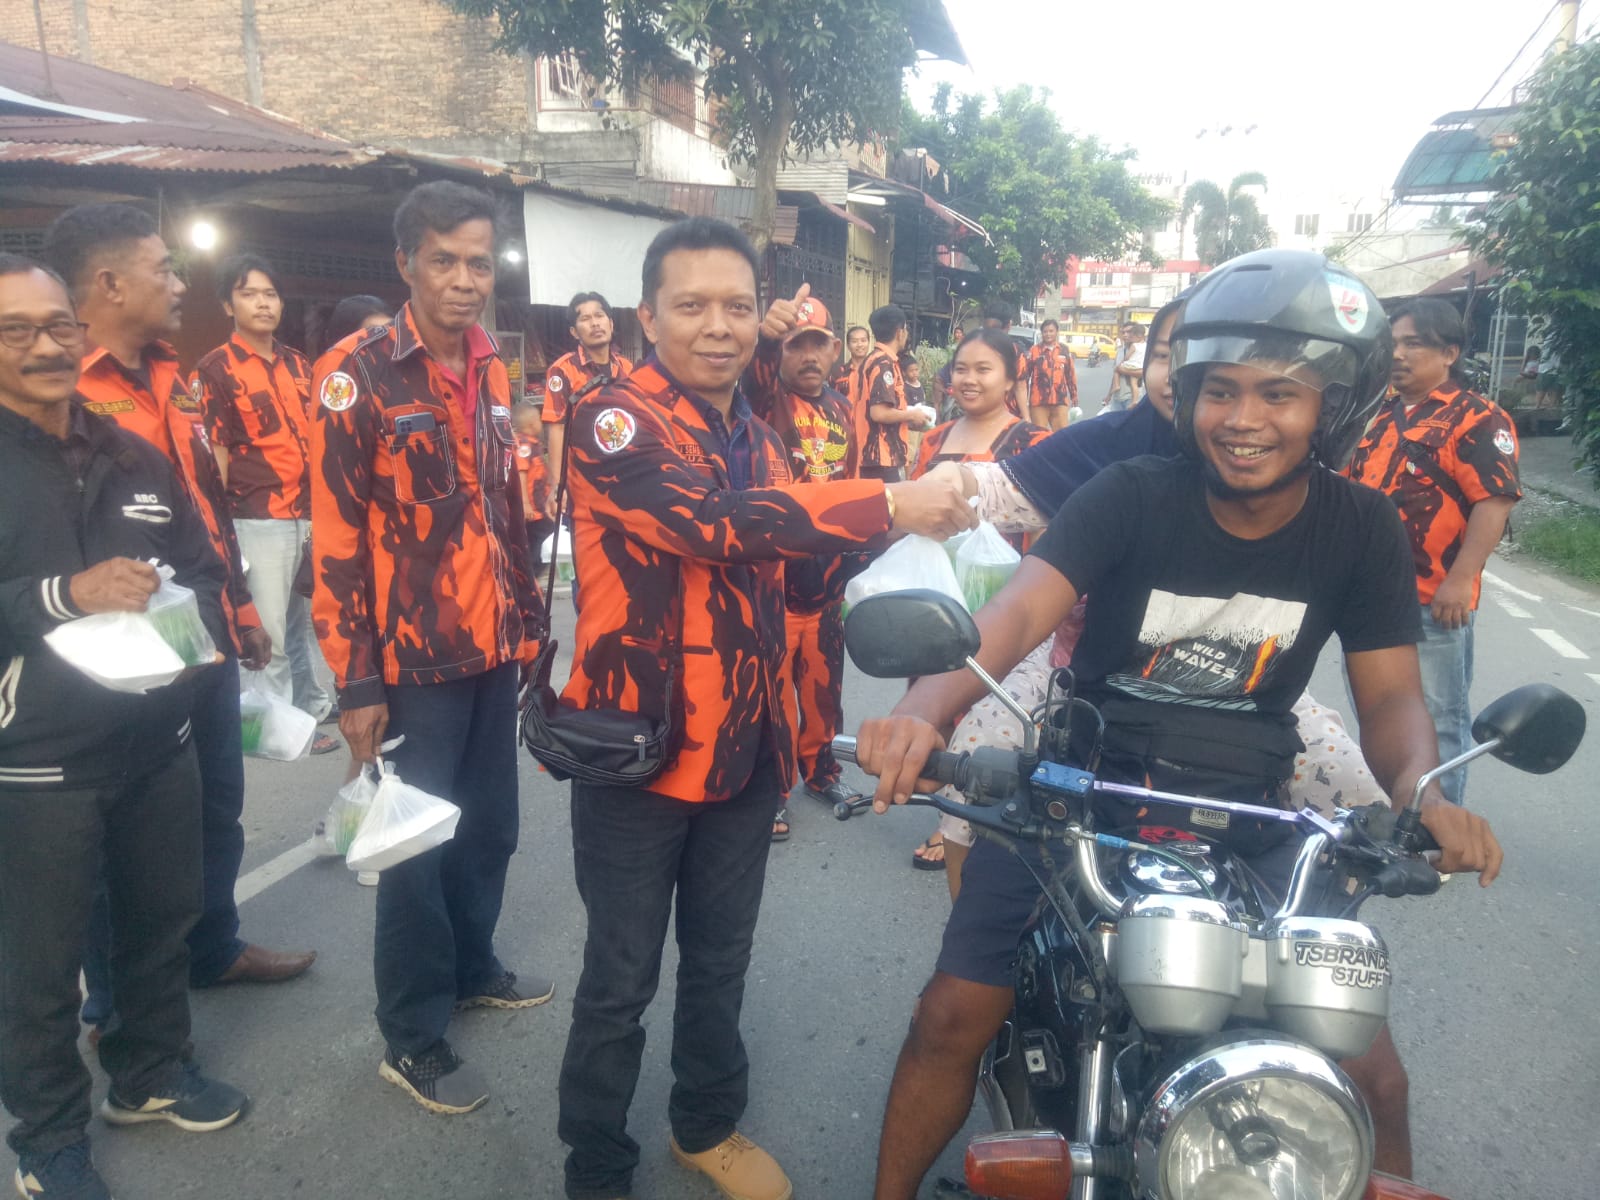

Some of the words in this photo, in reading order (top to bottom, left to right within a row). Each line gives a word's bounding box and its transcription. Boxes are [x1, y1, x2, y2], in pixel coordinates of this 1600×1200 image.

[1192, 641, 1227, 661] WILD
[1173, 648, 1238, 681] WAVES
[1332, 966, 1384, 988] STUFF
